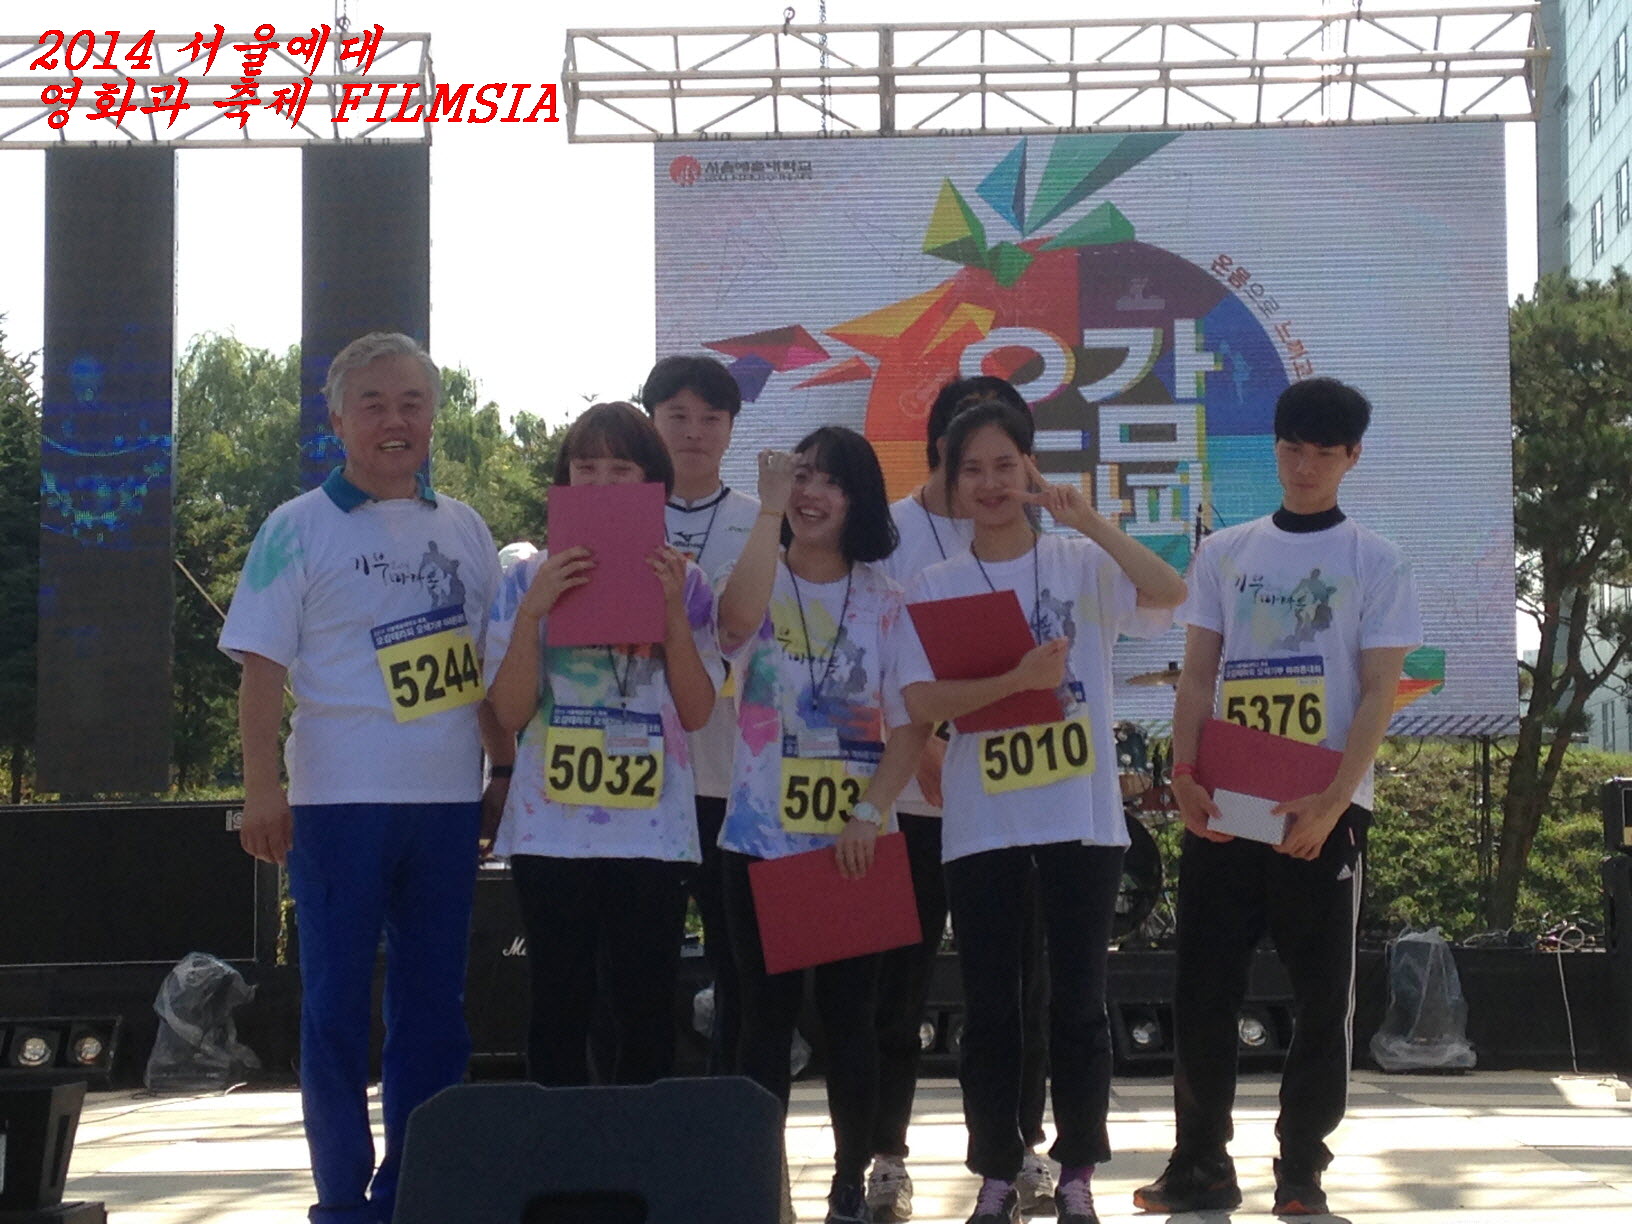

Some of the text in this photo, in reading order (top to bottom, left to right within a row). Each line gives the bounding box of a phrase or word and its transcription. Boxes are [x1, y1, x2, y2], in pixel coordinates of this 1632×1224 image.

[1211, 253, 1281, 317] 온몸으로
[389, 643, 479, 708] 5244
[1227, 692, 1322, 735] 5376
[549, 744, 658, 797] 5032
[985, 722, 1089, 781] 5010
[784, 775, 860, 823] 503
